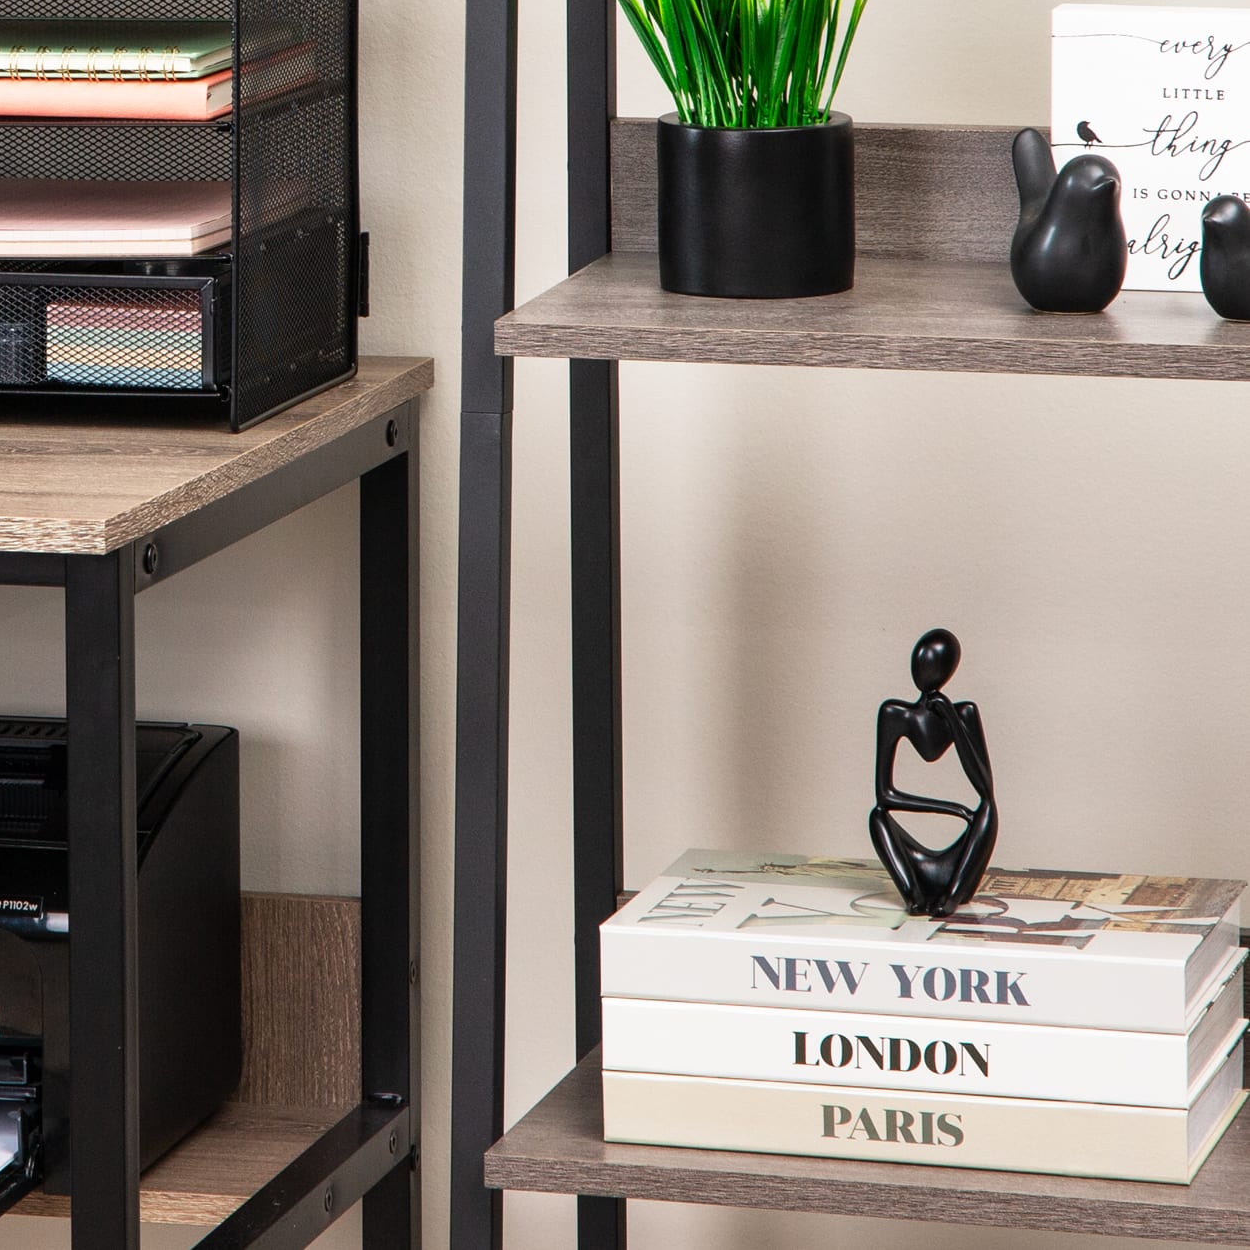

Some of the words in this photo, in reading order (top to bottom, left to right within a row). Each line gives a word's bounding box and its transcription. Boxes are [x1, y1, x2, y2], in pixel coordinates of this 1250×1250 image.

[1159, 35, 1234, 80] every
[1162, 87, 1226, 101] LITTLE
[1142, 110, 1233, 182] thing
[1132, 188, 1149, 200] IS
[1156, 188, 1222, 202] GONN
[1127, 213, 1203, 281] alrig
[2, 900, 39, 912] P1102w
[637, 877, 746, 928] NEW
[749, 954, 871, 996] NEW
[888, 963, 1032, 1008] YORK
[791, 1030, 992, 1078] LONDON
[819, 1103, 966, 1148] PARIS
